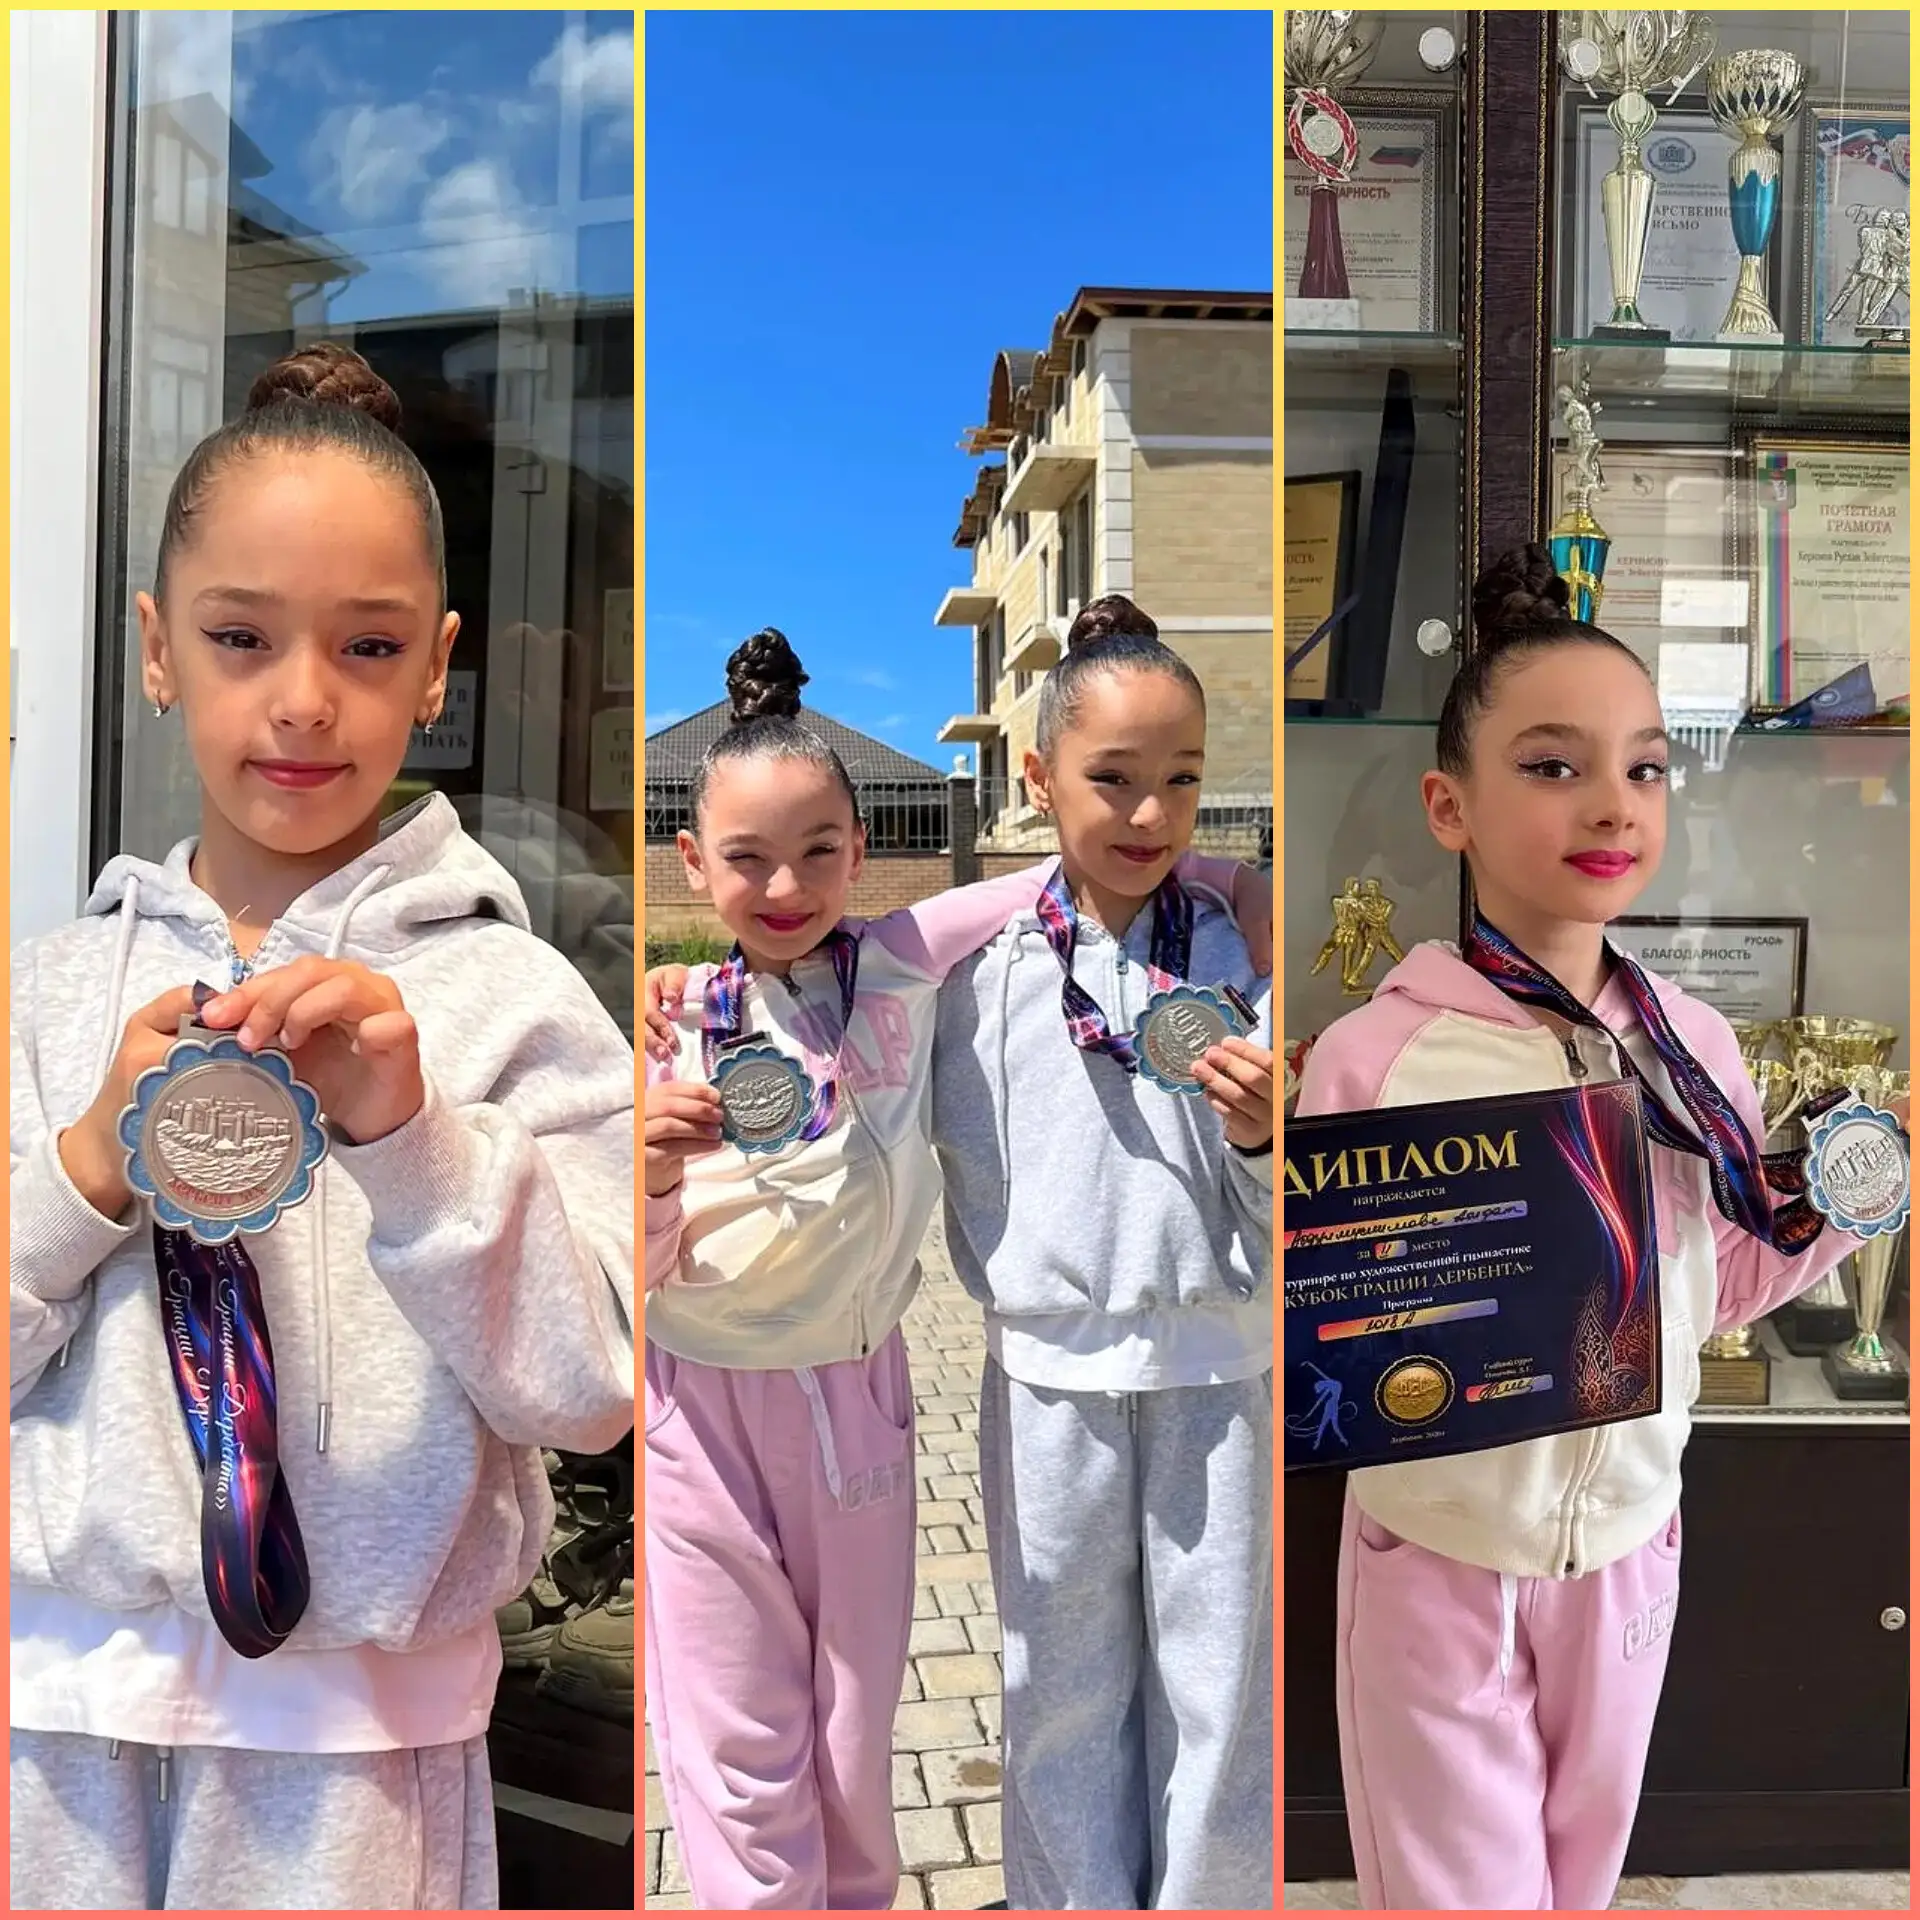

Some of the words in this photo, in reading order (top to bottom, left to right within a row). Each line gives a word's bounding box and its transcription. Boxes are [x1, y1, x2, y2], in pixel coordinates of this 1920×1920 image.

[1294, 185, 1390, 199] БЛАРНОСТЬ
[1827, 520, 1892, 534] ГРАМОТА
[1641, 948, 1752, 960] БЛАГОДАРНОСТЬ
[1352, 1185, 1447, 1208] награждается
[1356, 1250, 1372, 1260] за
[1411, 1238, 1452, 1253] место
[1284, 1273, 1338, 1294] турнире
[1340, 1271, 1357, 1281] по
[1359, 1252, 1461, 1281] художественной
[1462, 1244, 1533, 1264] гимнастике
[1352, 1274, 1429, 1299] ГРАЦИИ
[1382, 1295, 1434, 1312] Программа
